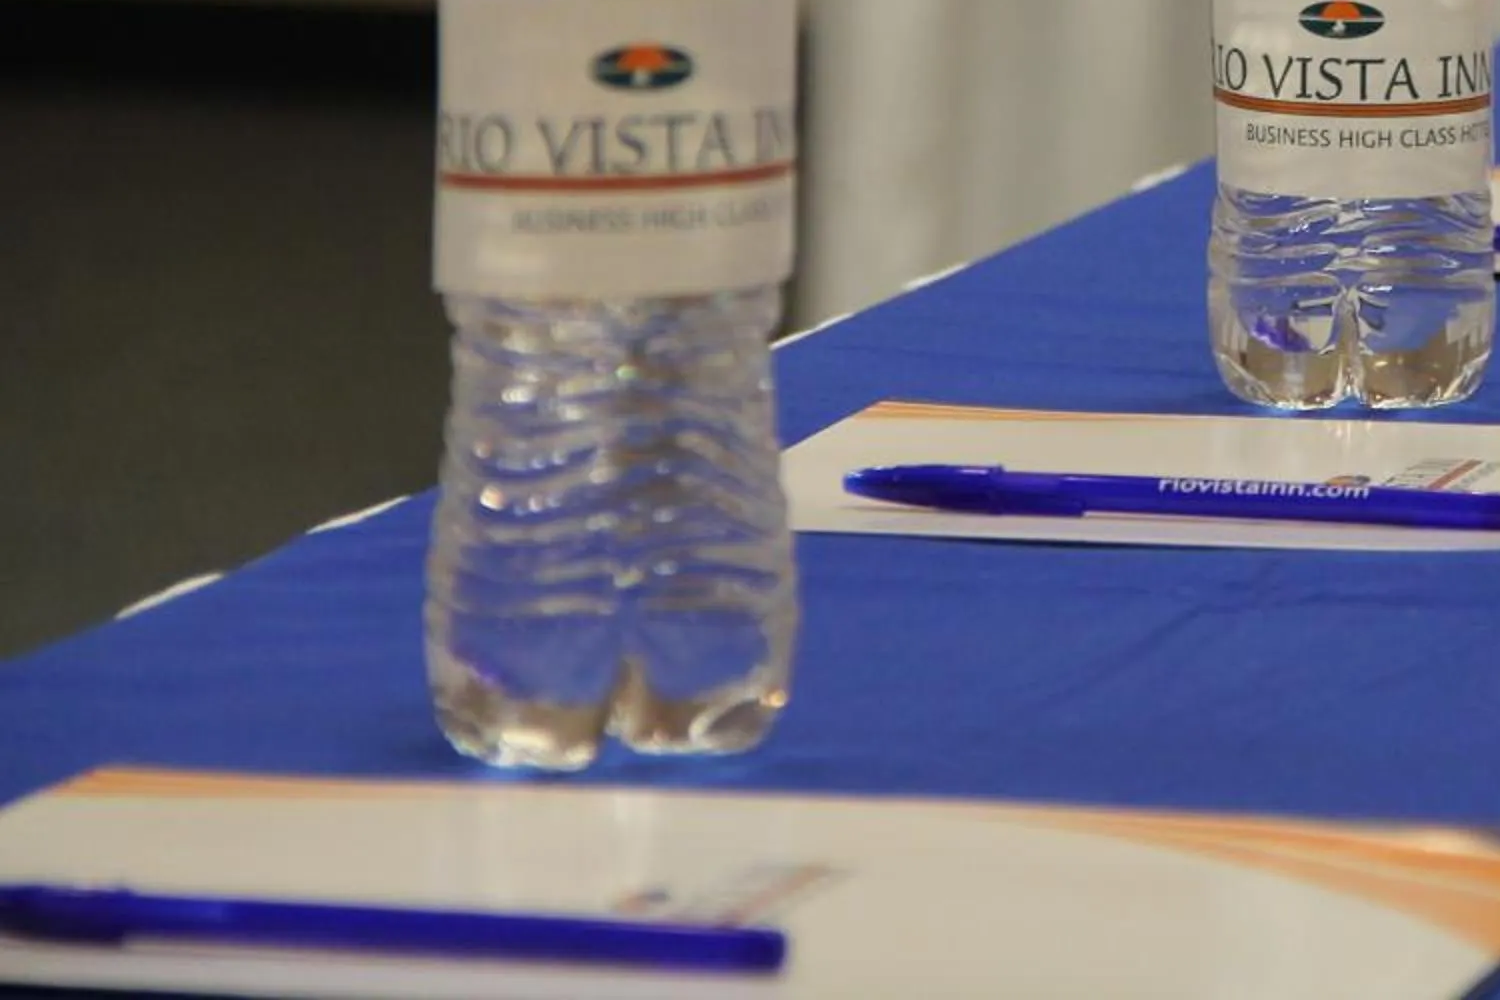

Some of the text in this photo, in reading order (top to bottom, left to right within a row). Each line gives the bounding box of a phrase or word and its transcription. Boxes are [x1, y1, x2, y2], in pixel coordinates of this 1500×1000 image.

[1212, 43, 1491, 101] IO VISTA INN
[535, 110, 736, 175] VISTA
[1247, 122, 1331, 148] BUSINESS
[1338, 129, 1393, 149] HIGH
[1400, 125, 1457, 147] CLASS
[1158, 477, 1371, 499] riovistainn.com
